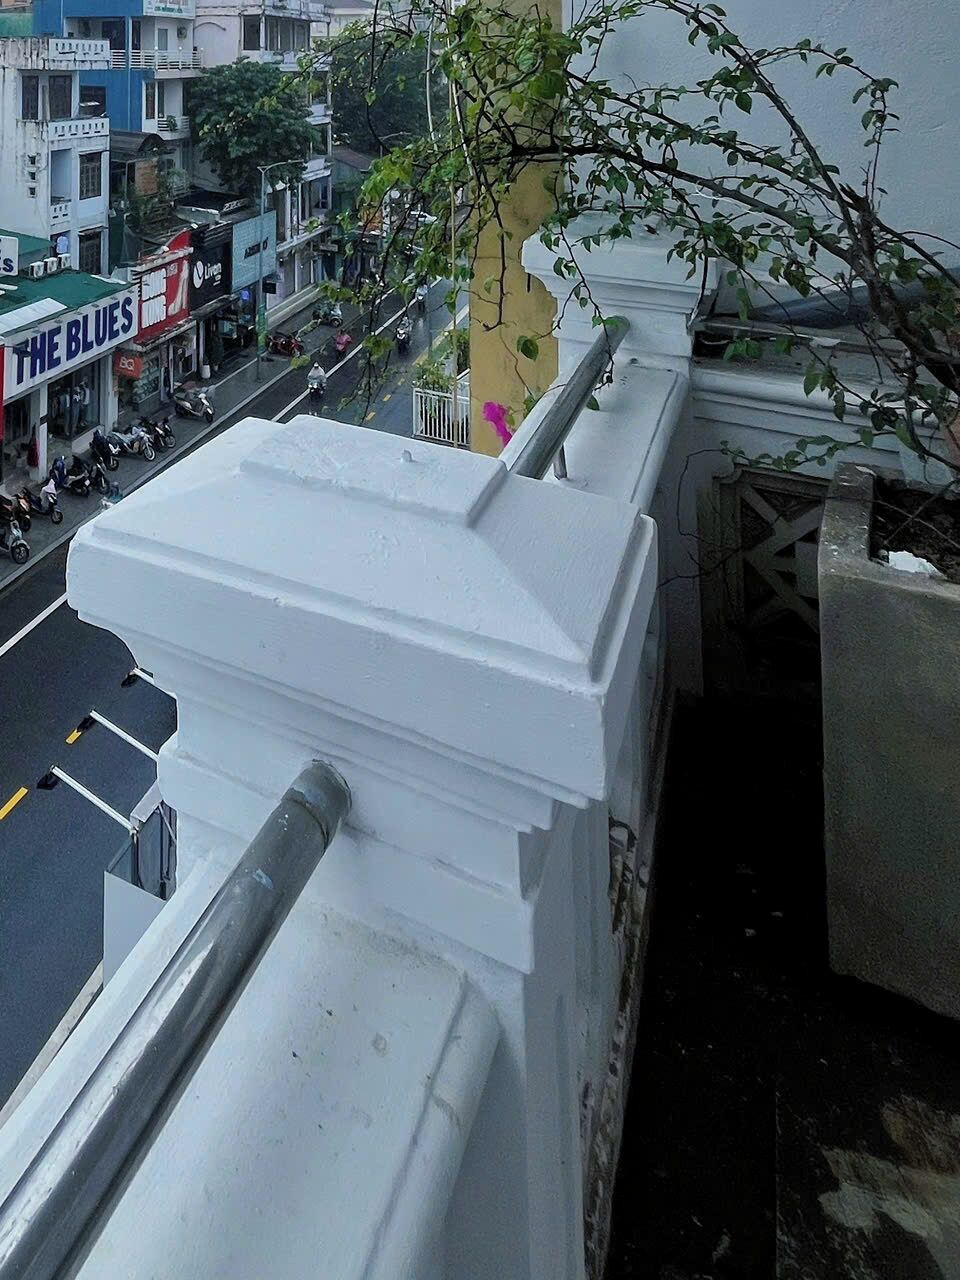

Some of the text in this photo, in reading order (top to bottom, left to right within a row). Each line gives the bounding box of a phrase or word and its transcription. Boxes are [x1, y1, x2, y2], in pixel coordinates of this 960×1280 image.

[14, 325, 62, 385] THE
[66, 296, 134, 362] BLUES
[119, 356, 135, 372] BQ
